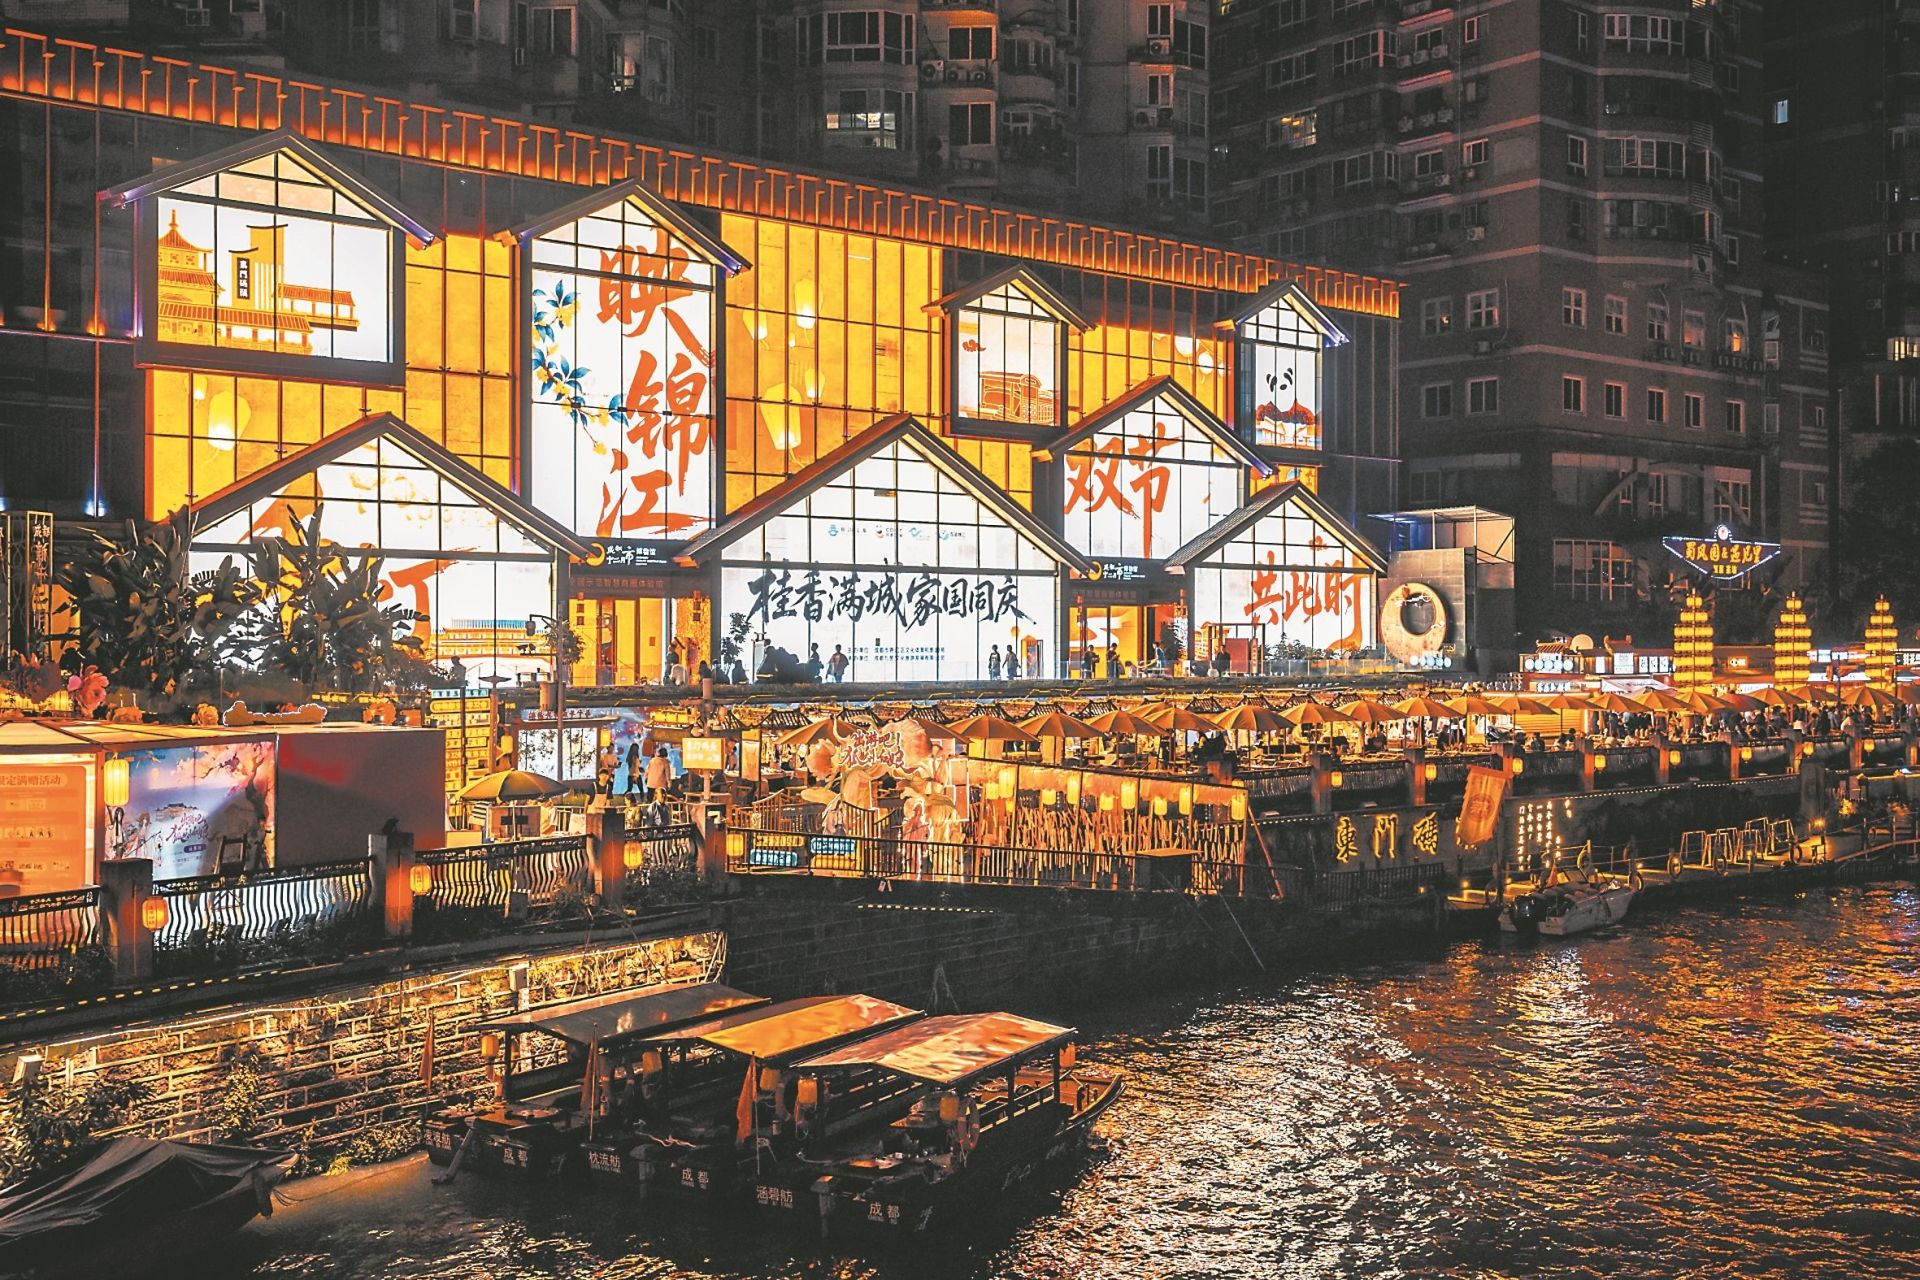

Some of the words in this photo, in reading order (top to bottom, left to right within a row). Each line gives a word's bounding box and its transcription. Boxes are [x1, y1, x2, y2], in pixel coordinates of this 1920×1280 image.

[596, 227, 716, 536] 映锦江
[1064, 422, 1181, 558] 双节
[747, 552, 1036, 632] 桂香满城家国同庆
[1244, 548, 1369, 650] 共此时
[1336, 812, 1478, 863] 東門碼
[681, 1167, 709, 1184] 成都
[869, 1202, 900, 1219] 成都
